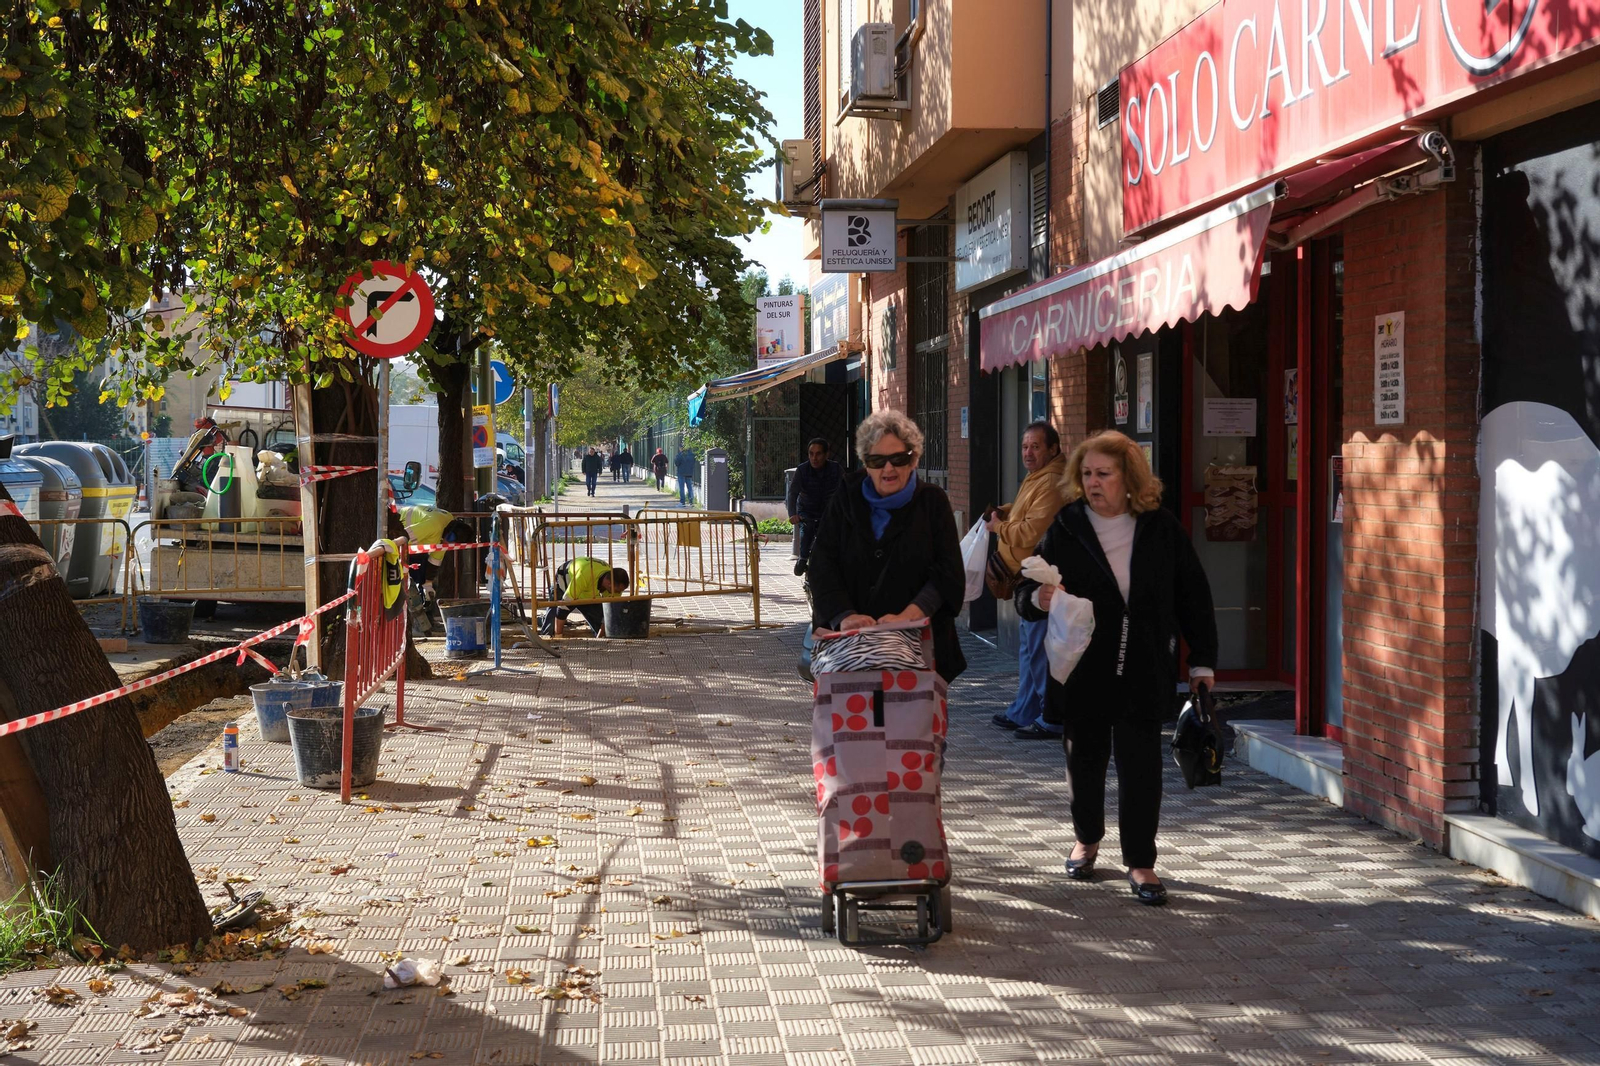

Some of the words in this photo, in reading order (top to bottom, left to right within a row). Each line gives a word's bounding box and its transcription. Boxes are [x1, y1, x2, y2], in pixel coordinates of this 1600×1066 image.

[1125, 50, 1220, 187] SOLO
[967, 189, 996, 235] BECORT
[832, 247, 880, 256] PELUQUERÍA
[882, 248, 888, 256] Y
[826, 256, 864, 265] ESTÉTICA
[865, 257, 893, 265] UNISEX
[763, 300, 793, 309] PINTURAS
[1011, 252, 1197, 356] CARNICERIA
[766, 311, 778, 319] DEL
